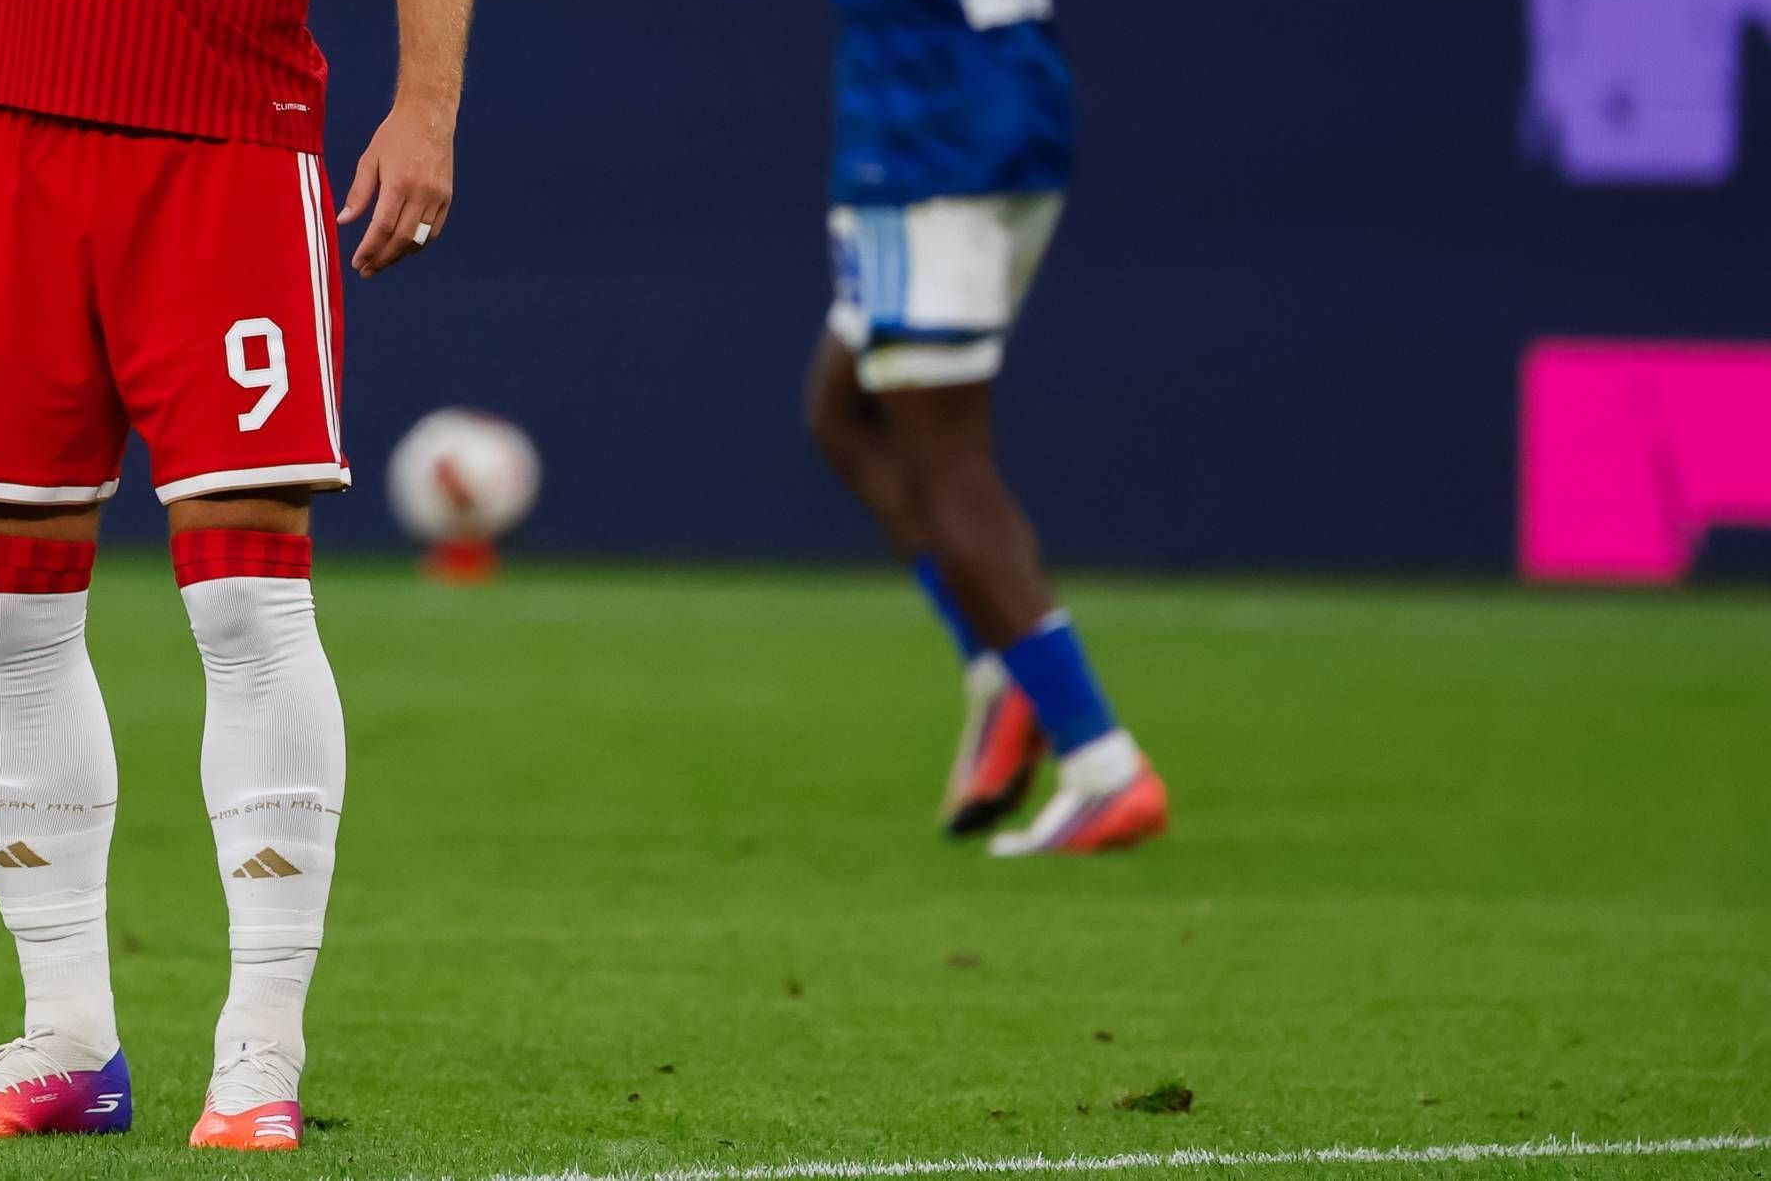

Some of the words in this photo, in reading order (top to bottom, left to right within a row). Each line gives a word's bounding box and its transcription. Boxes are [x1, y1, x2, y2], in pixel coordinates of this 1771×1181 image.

[224, 317, 290, 432] 9
[46, 802, 86, 813] MIA
[219, 809, 240, 820] MIA
[244, 800, 281, 814] SAN
[290, 799, 323, 813] MIA
